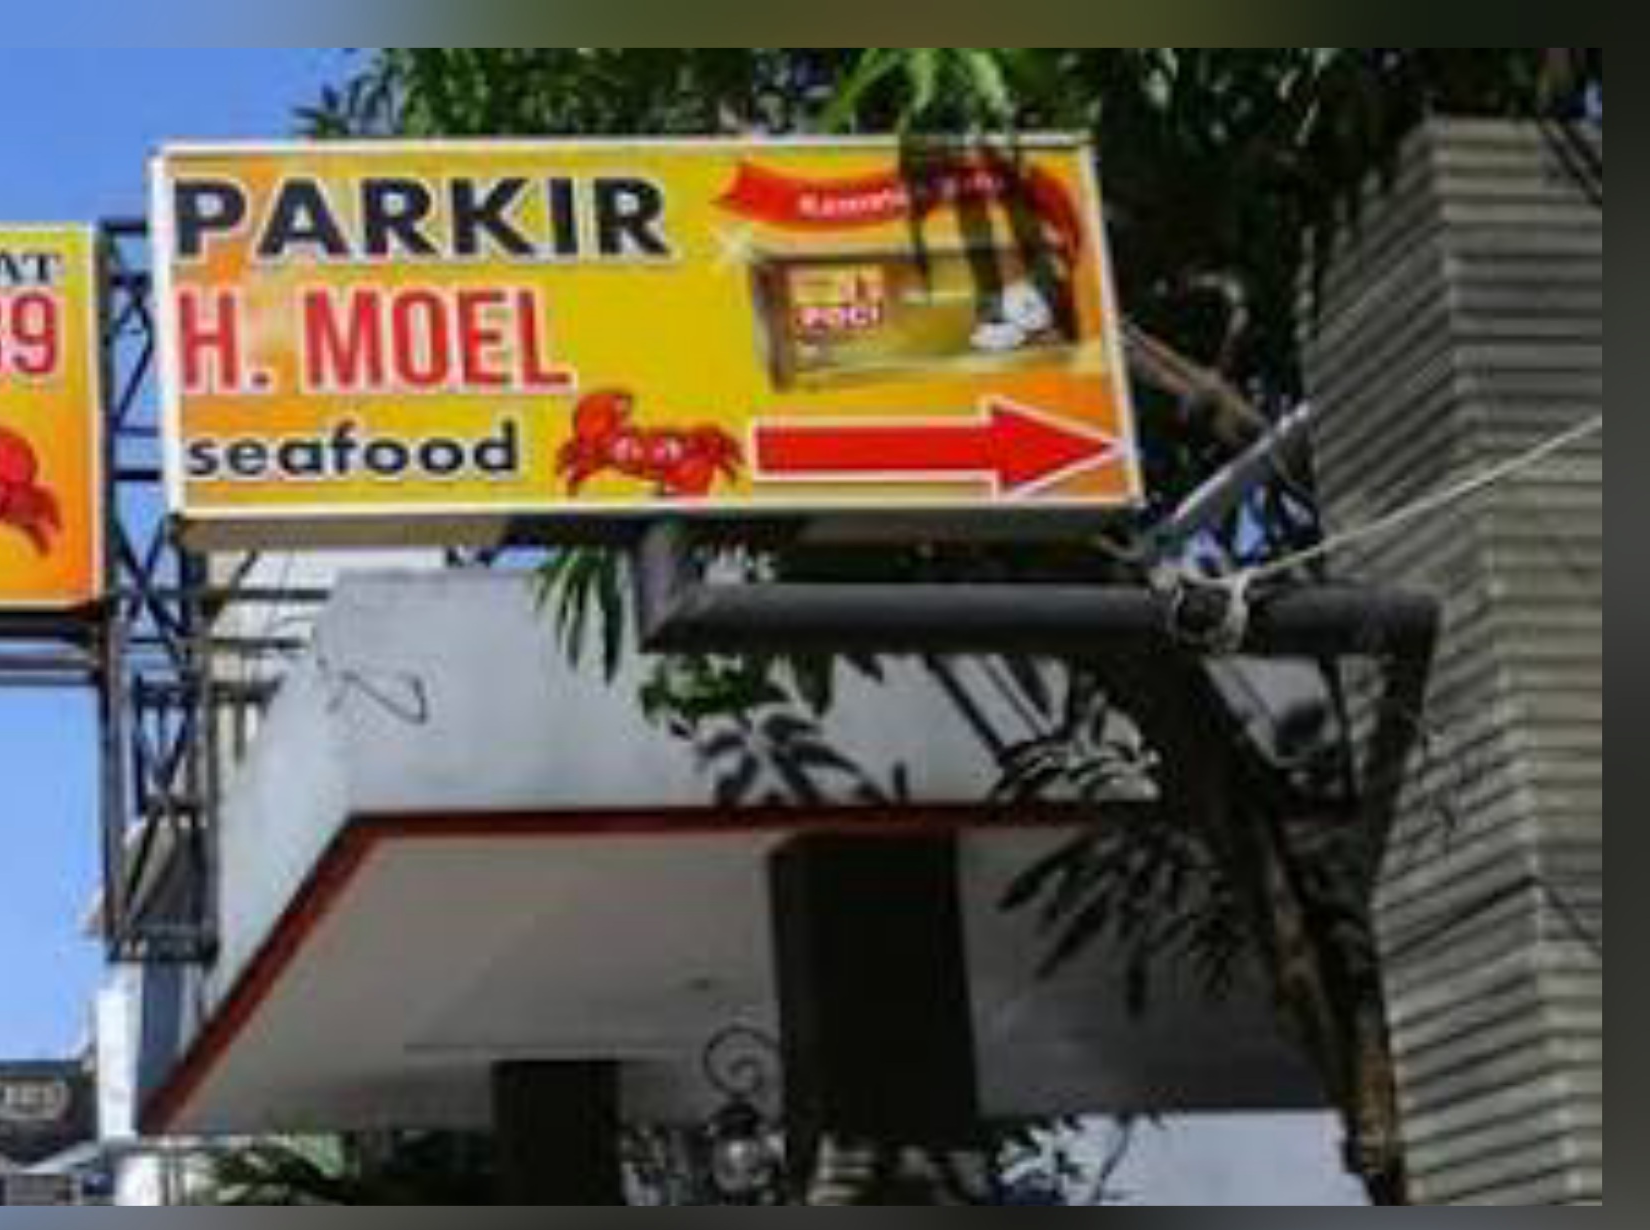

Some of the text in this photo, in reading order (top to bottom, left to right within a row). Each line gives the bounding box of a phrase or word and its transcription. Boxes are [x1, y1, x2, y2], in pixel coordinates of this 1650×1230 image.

[173, 176, 672, 257] PARKIR
[176, 288, 572, 388] H. MOEL
[186, 418, 518, 476] seafood
